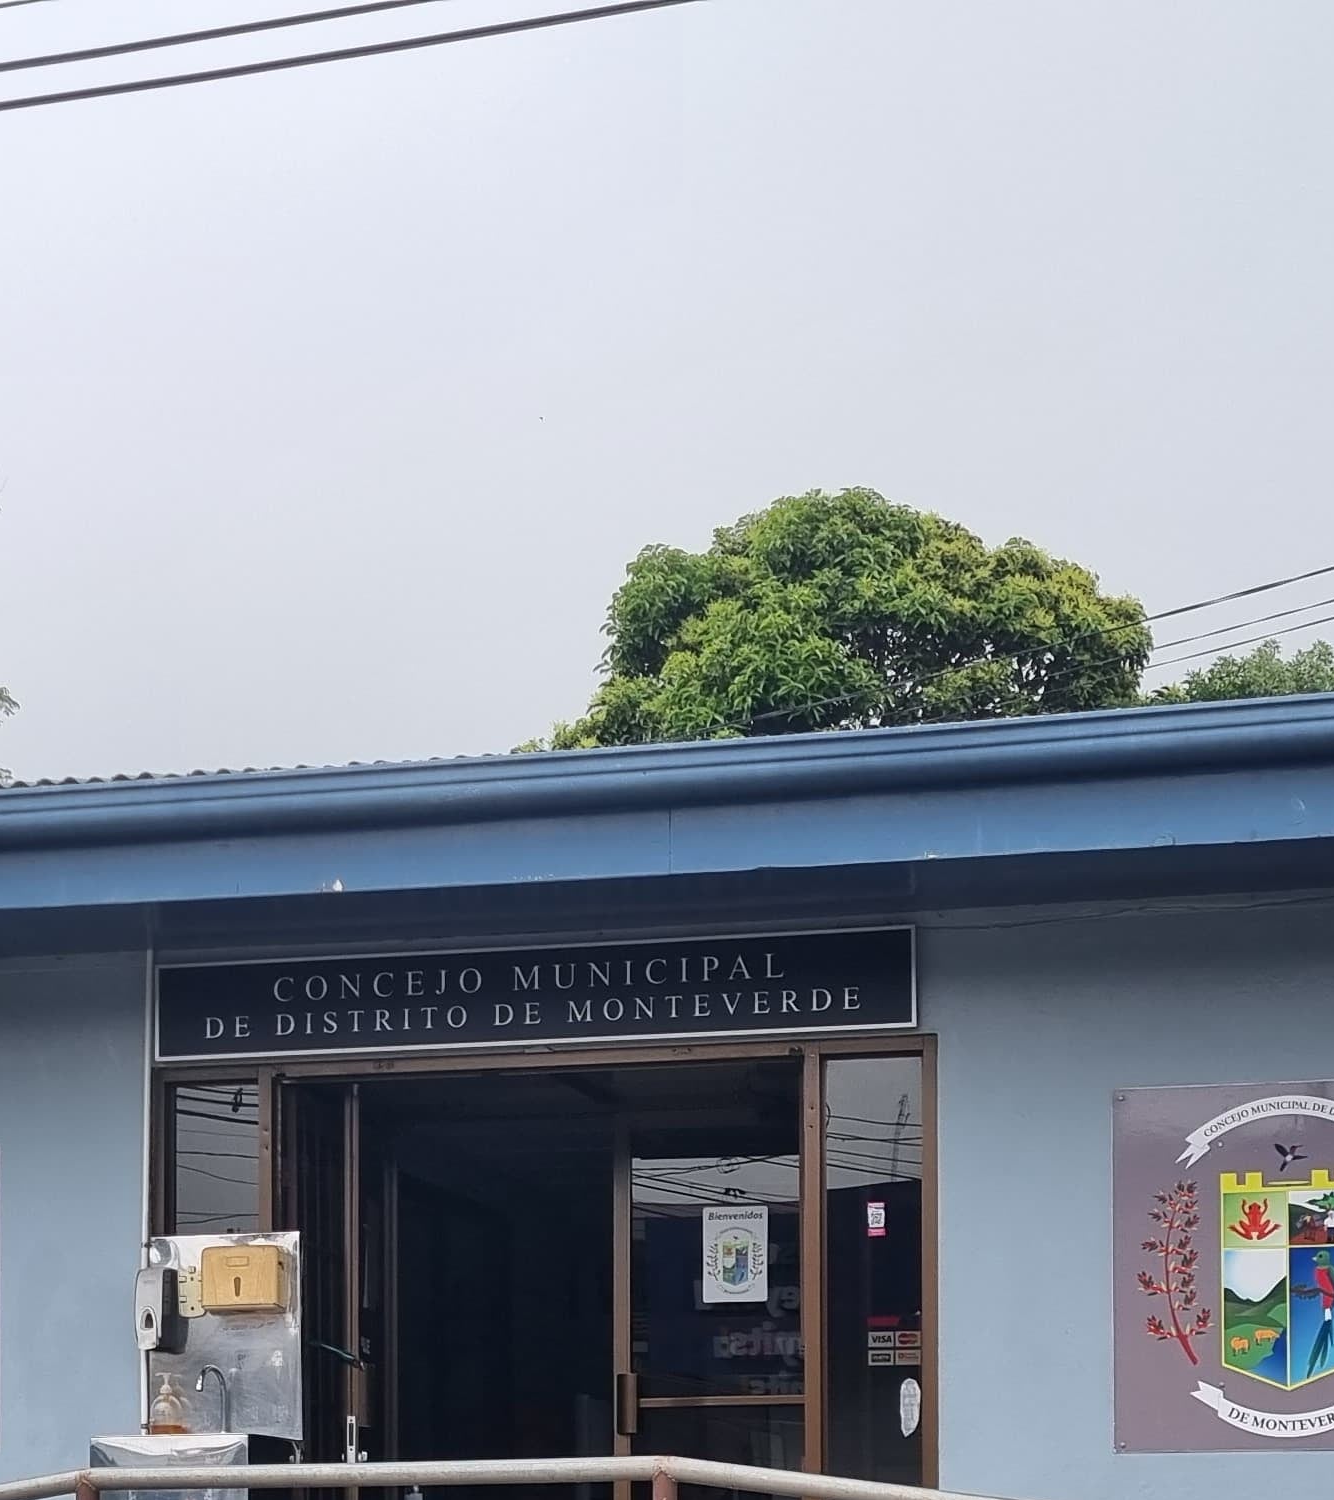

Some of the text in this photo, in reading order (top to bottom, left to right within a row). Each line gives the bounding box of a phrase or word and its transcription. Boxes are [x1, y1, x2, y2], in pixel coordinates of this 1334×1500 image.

[271, 952, 786, 1003] CONCEJO MUNICIPAL
[204, 985, 862, 1040] DE DISTRITO DE MONTEVERDE
[1203, 1109, 1249, 1137] CONCEJO
[1251, 1101, 1310, 1115] MUNICIPAL
[1313, 1102, 1327, 1113] DE
[708, 1211, 763, 1221] Bienvenidos
[870, 1334, 893, 1344] VISA
[1228, 1407, 1250, 1424] DE
